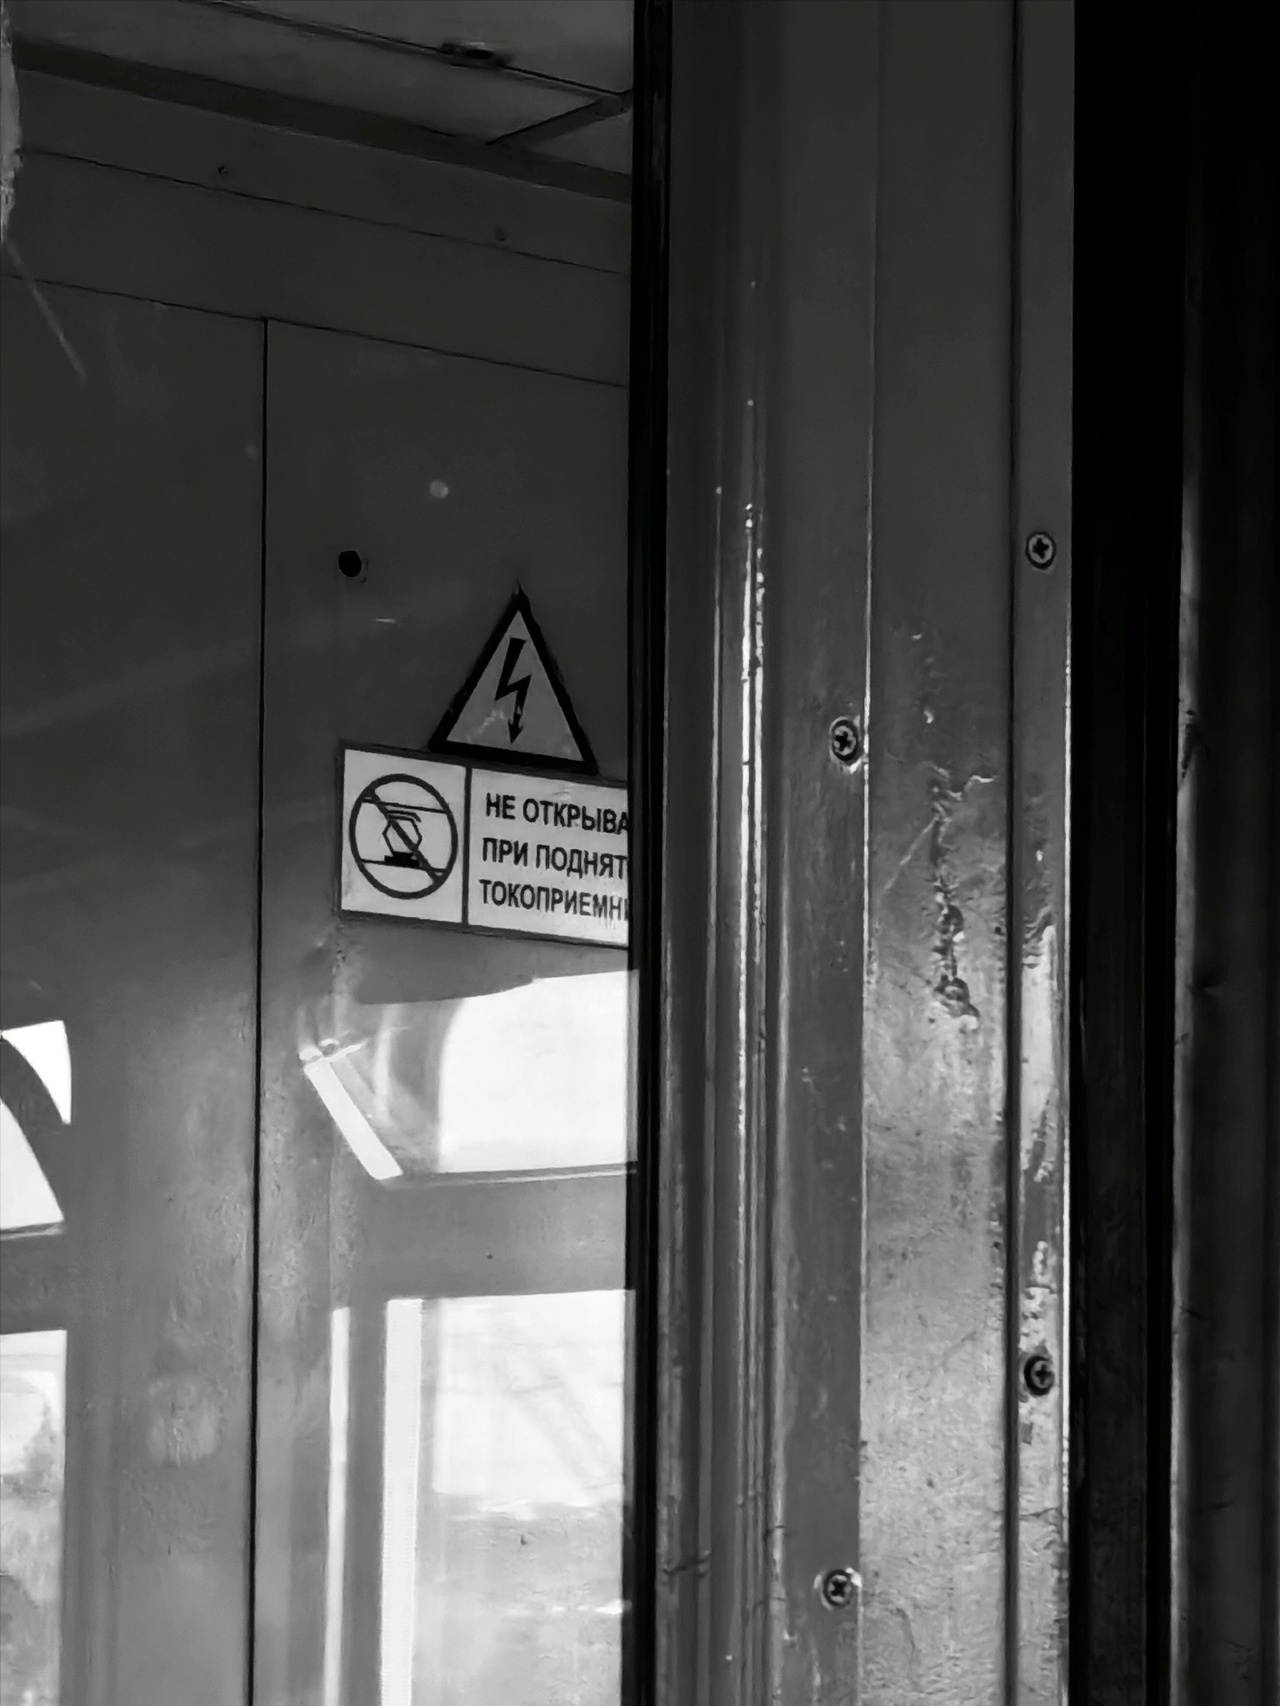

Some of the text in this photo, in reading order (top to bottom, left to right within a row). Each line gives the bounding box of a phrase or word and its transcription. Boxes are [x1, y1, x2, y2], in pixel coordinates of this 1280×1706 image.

[485, 792, 628, 835] НЕ ОТКРЫВА
[482, 837, 628, 879] ПРИ ПОДНЯТ
